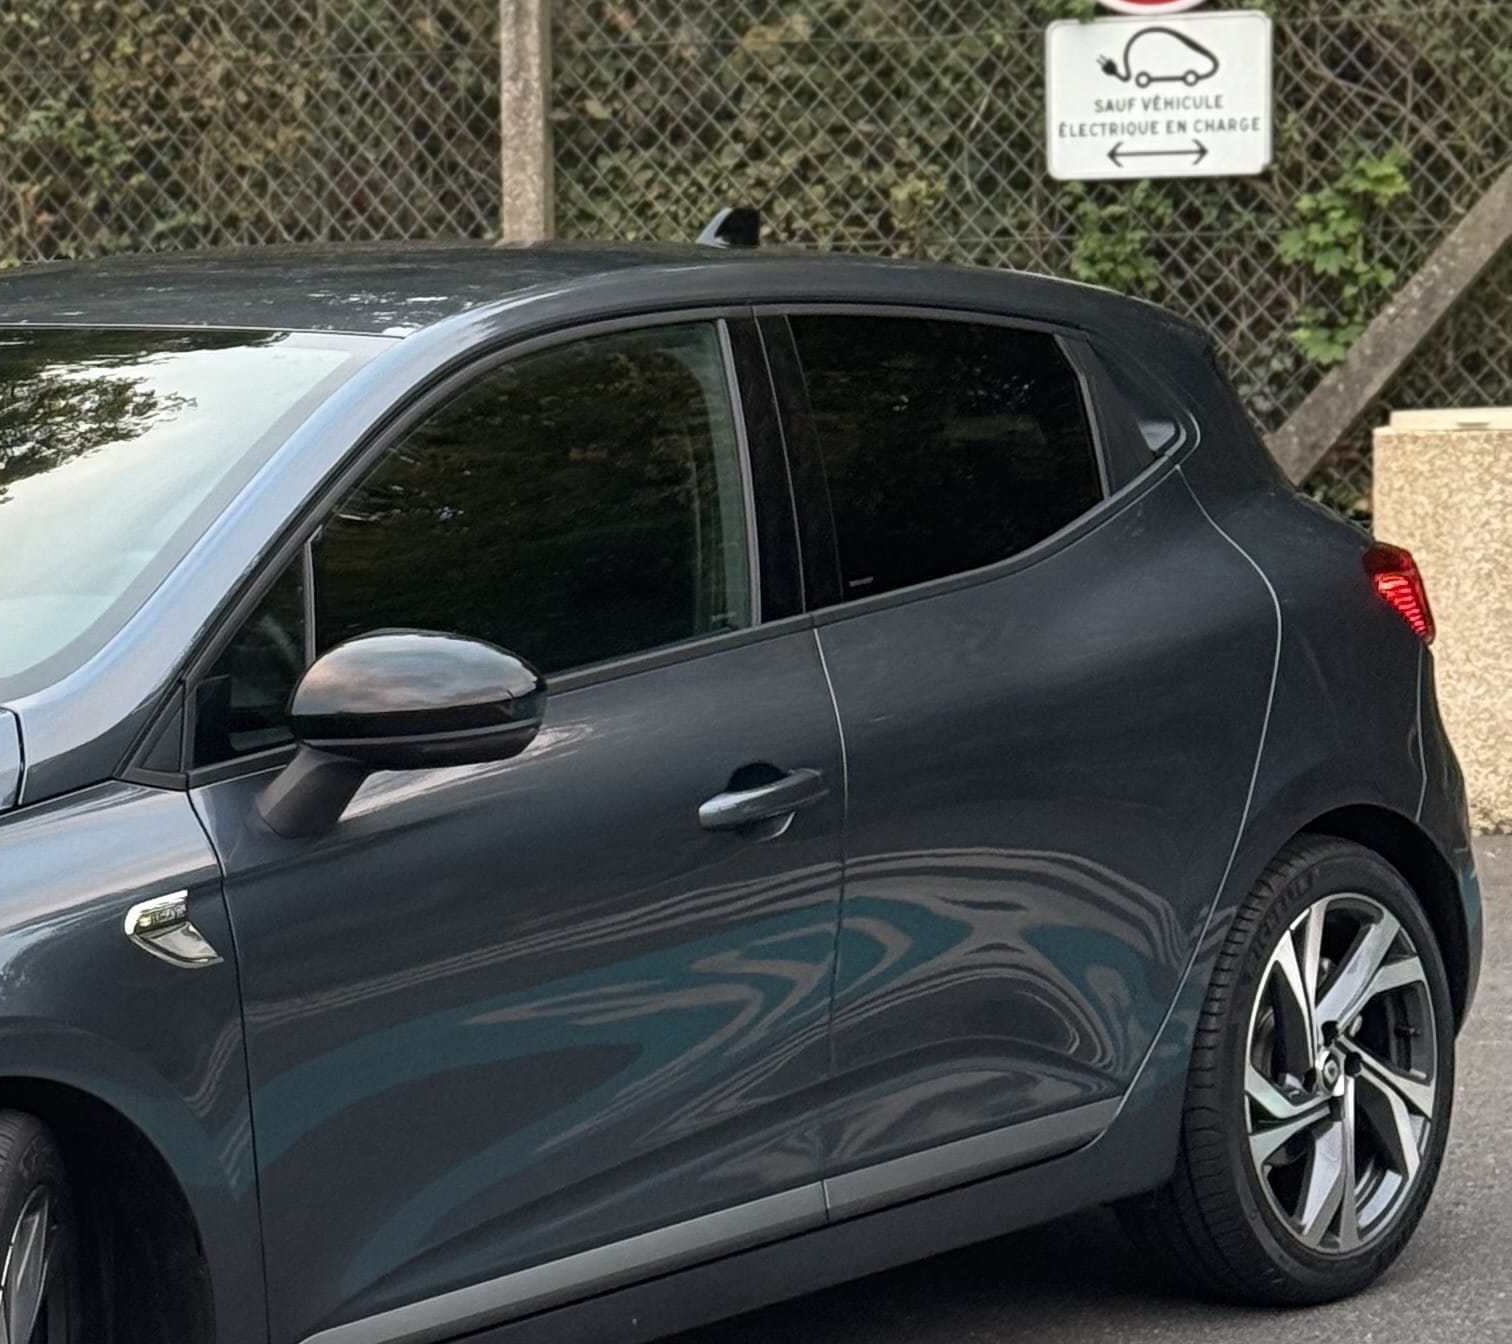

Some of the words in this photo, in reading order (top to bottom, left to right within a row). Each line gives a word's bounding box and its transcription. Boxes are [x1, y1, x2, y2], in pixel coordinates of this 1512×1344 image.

[1094, 99, 1136, 113] SAUF
[1141, 93, 1224, 112] VÉHICULE
[1058, 120, 1159, 138] ÉLECTRIQUE
[1165, 120, 1188, 135] EN
[1193, 116, 1261, 134] CHARGE
